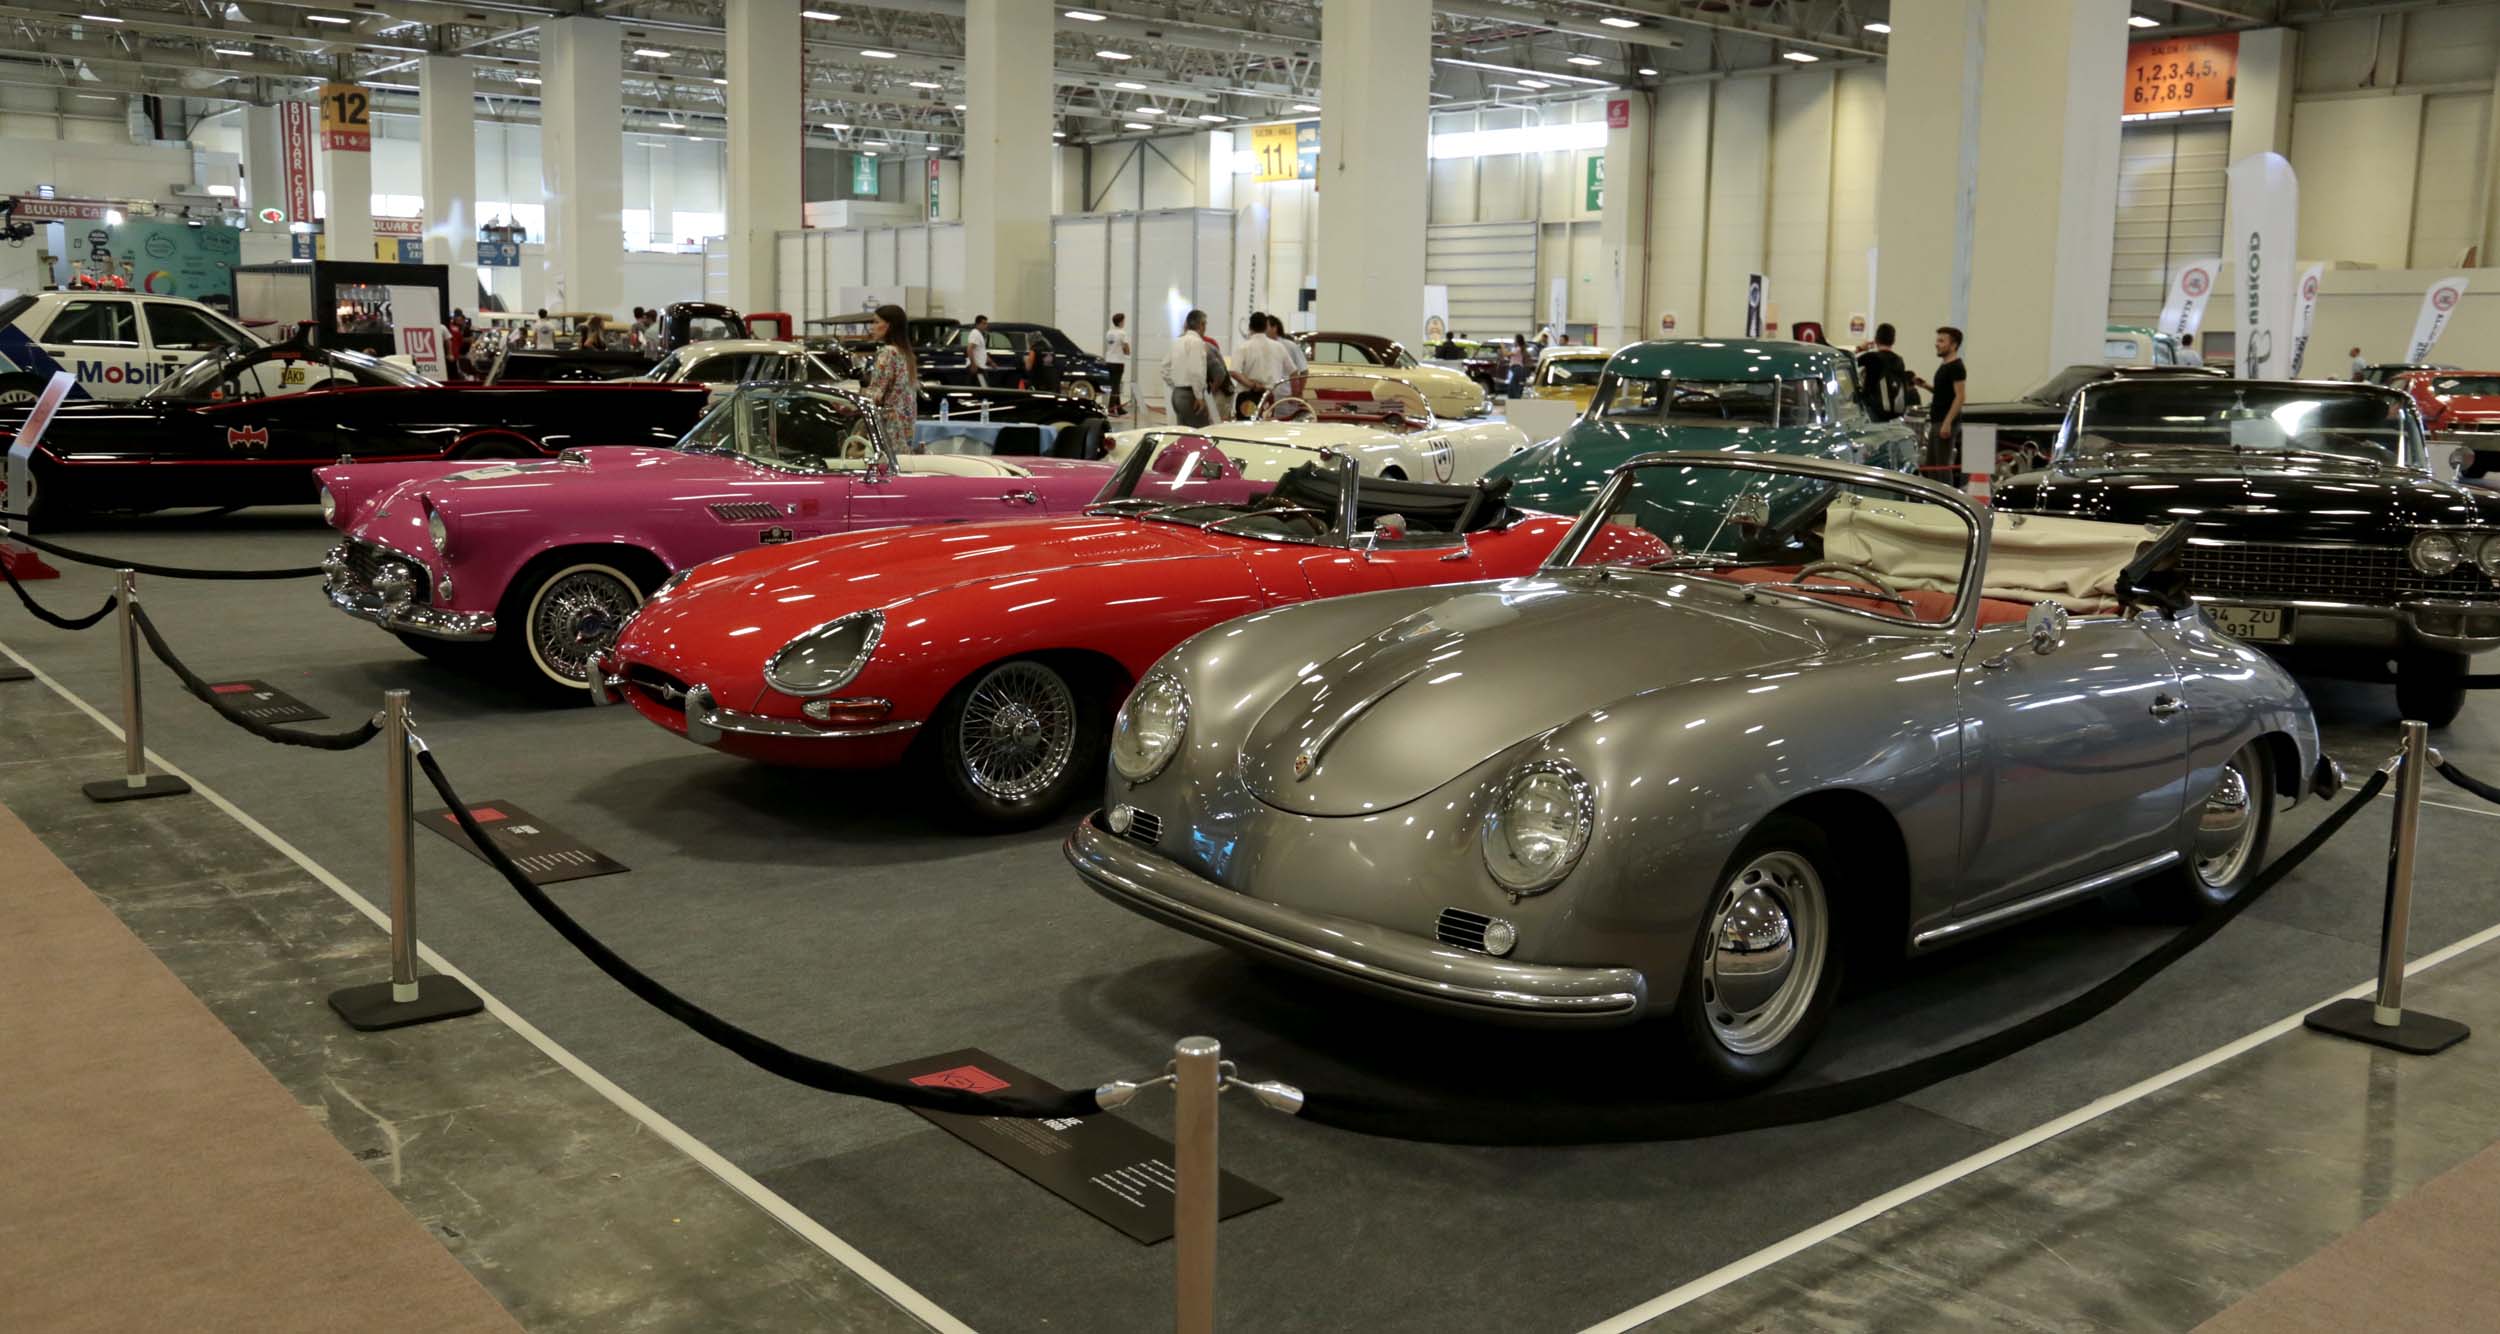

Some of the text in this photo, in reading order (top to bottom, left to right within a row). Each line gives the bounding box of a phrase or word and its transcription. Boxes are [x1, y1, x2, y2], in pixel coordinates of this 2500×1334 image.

[2136, 60, 2217, 83] 1,2,3,4,5,
[2133, 83, 2195, 102] 6,7,8,9
[332, 92, 368, 124] 12
[1263, 143, 1282, 177] 11
[24, 203, 77, 218] BULVAR
[372, 221, 409, 232] ULVAR
[76, 360, 160, 385] Mobil
[2208, 608, 2275, 623] 34 ZU
[2226, 623, 2255, 637] 931
